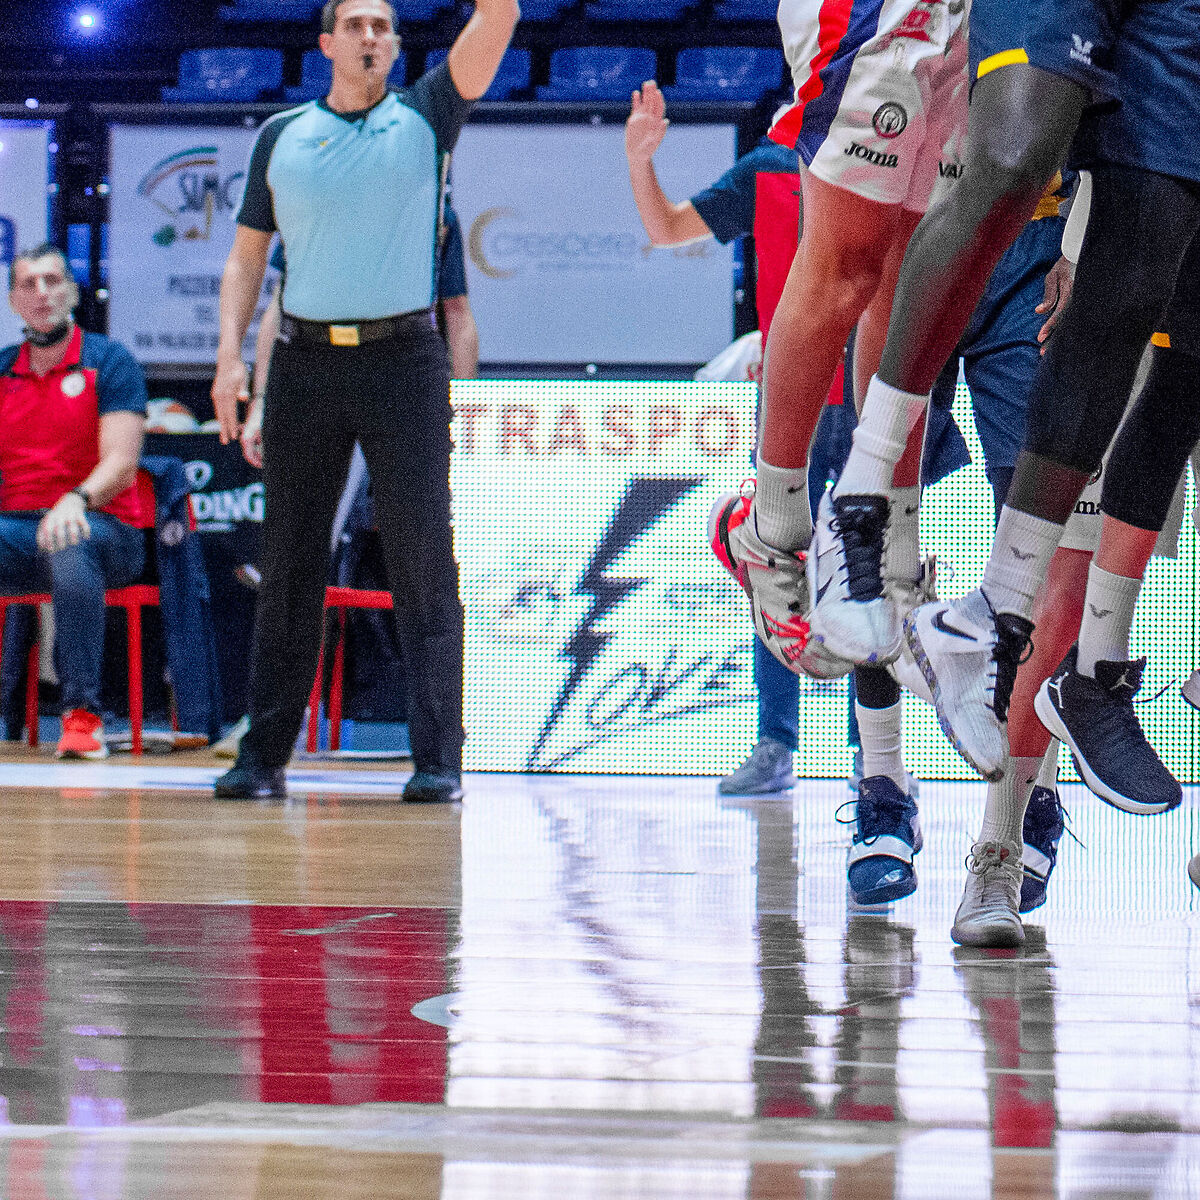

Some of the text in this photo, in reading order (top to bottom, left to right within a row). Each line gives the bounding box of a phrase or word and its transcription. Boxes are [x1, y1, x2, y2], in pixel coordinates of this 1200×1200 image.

[844, 141, 899, 168] Joma
[453, 403, 740, 458] TRASPO
[190, 483, 266, 523] DING
